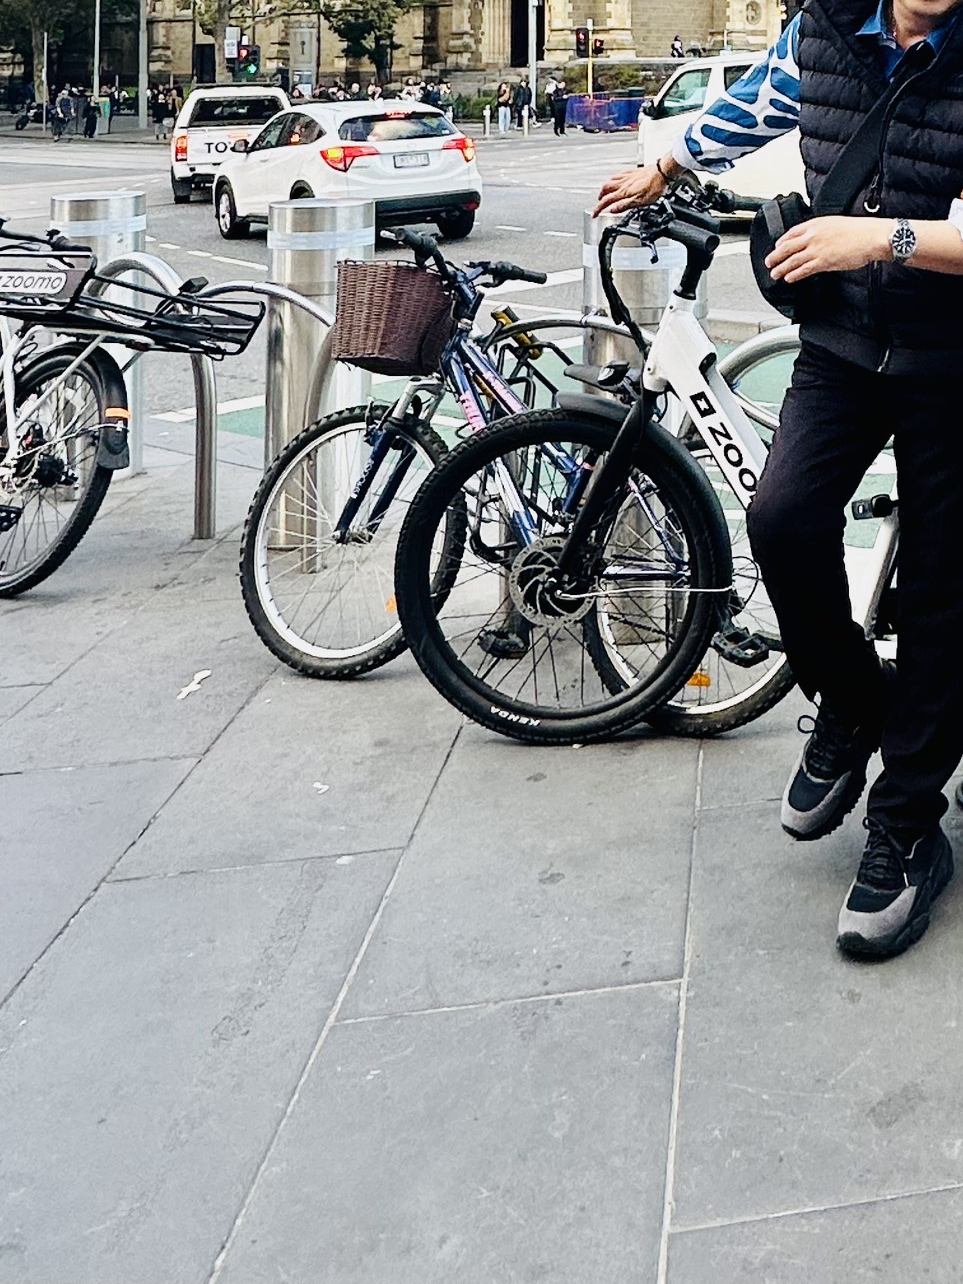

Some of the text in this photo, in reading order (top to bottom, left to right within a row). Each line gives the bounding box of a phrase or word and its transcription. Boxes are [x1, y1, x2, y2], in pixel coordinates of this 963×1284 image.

[204, 141, 231, 154] TO
[1, 276, 63, 290] zoomo
[707, 421, 758, 500] ZOO
[490, 705, 541, 726] KENDA
